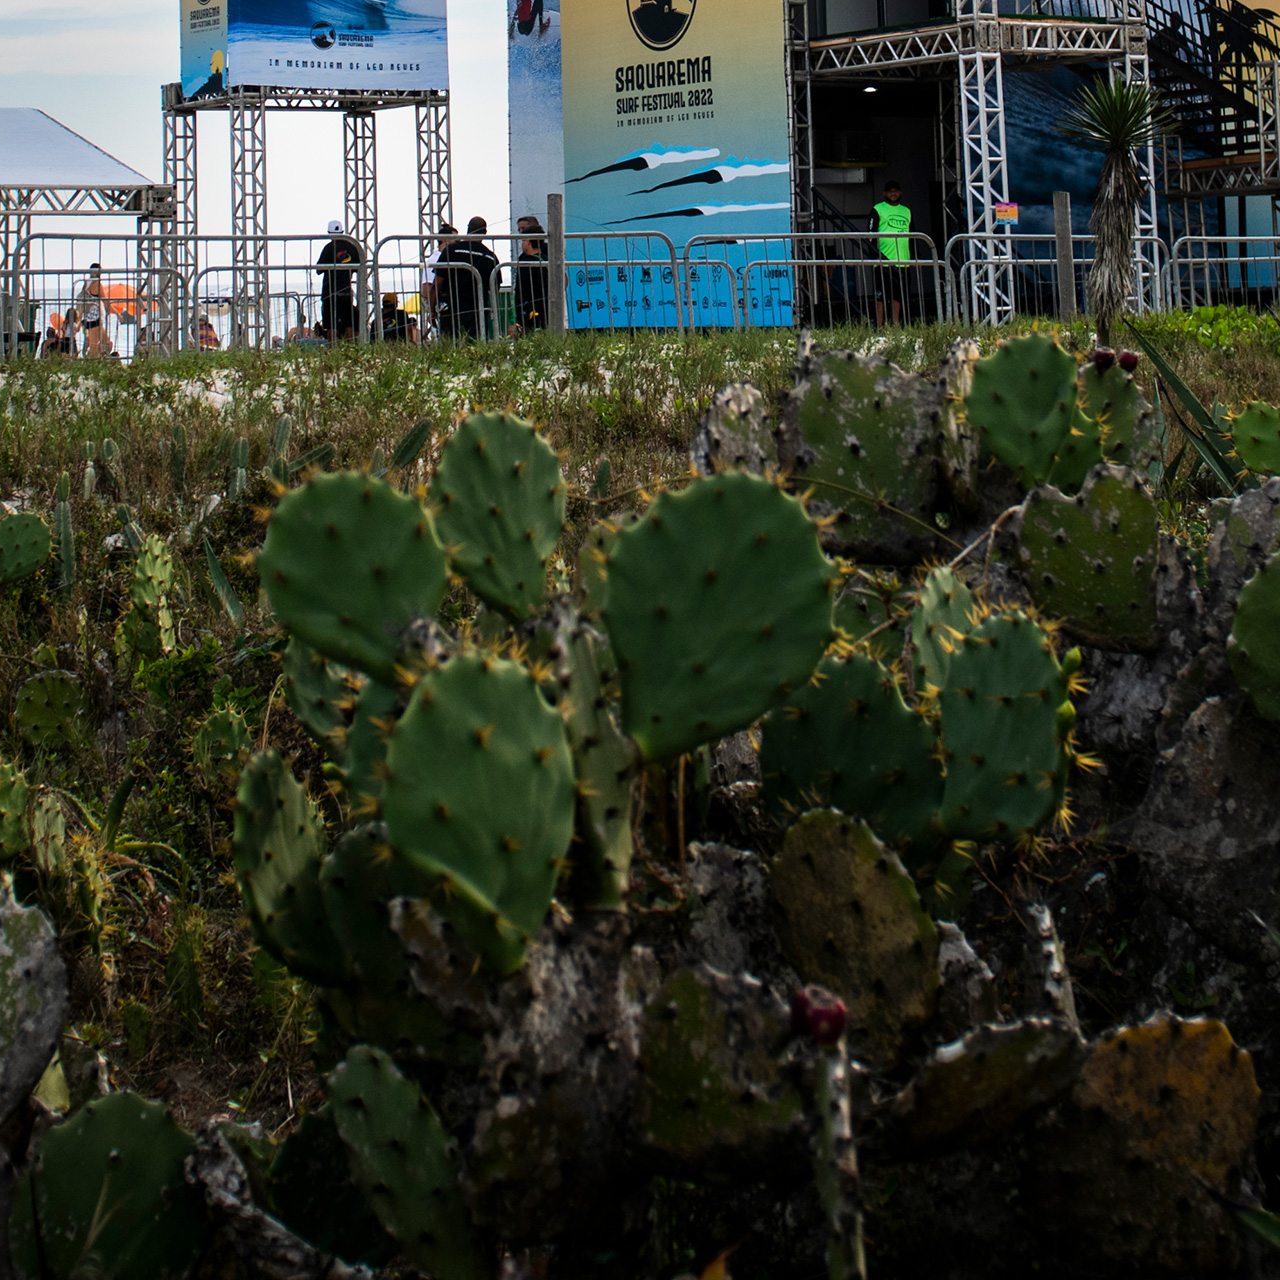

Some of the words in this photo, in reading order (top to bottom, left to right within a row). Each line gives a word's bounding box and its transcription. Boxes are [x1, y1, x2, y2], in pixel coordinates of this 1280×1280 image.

[269, 59, 280, 67] IN
[287, 59, 343, 70] MEMORIAM
[350, 62, 360, 70] OF
[367, 63, 384, 71] LEO
[391, 63, 421, 71] NEVES
[615, 56, 712, 93] SAQUAREMA
[617, 96, 640, 115] SURF
[642, 91, 686, 112] FESTIVAL
[688, 88, 714, 107] 2022
[628, 116, 663, 126] MEMORIAM
[678, 113, 690, 122] LEO
[693, 111, 715, 120] NEVES
